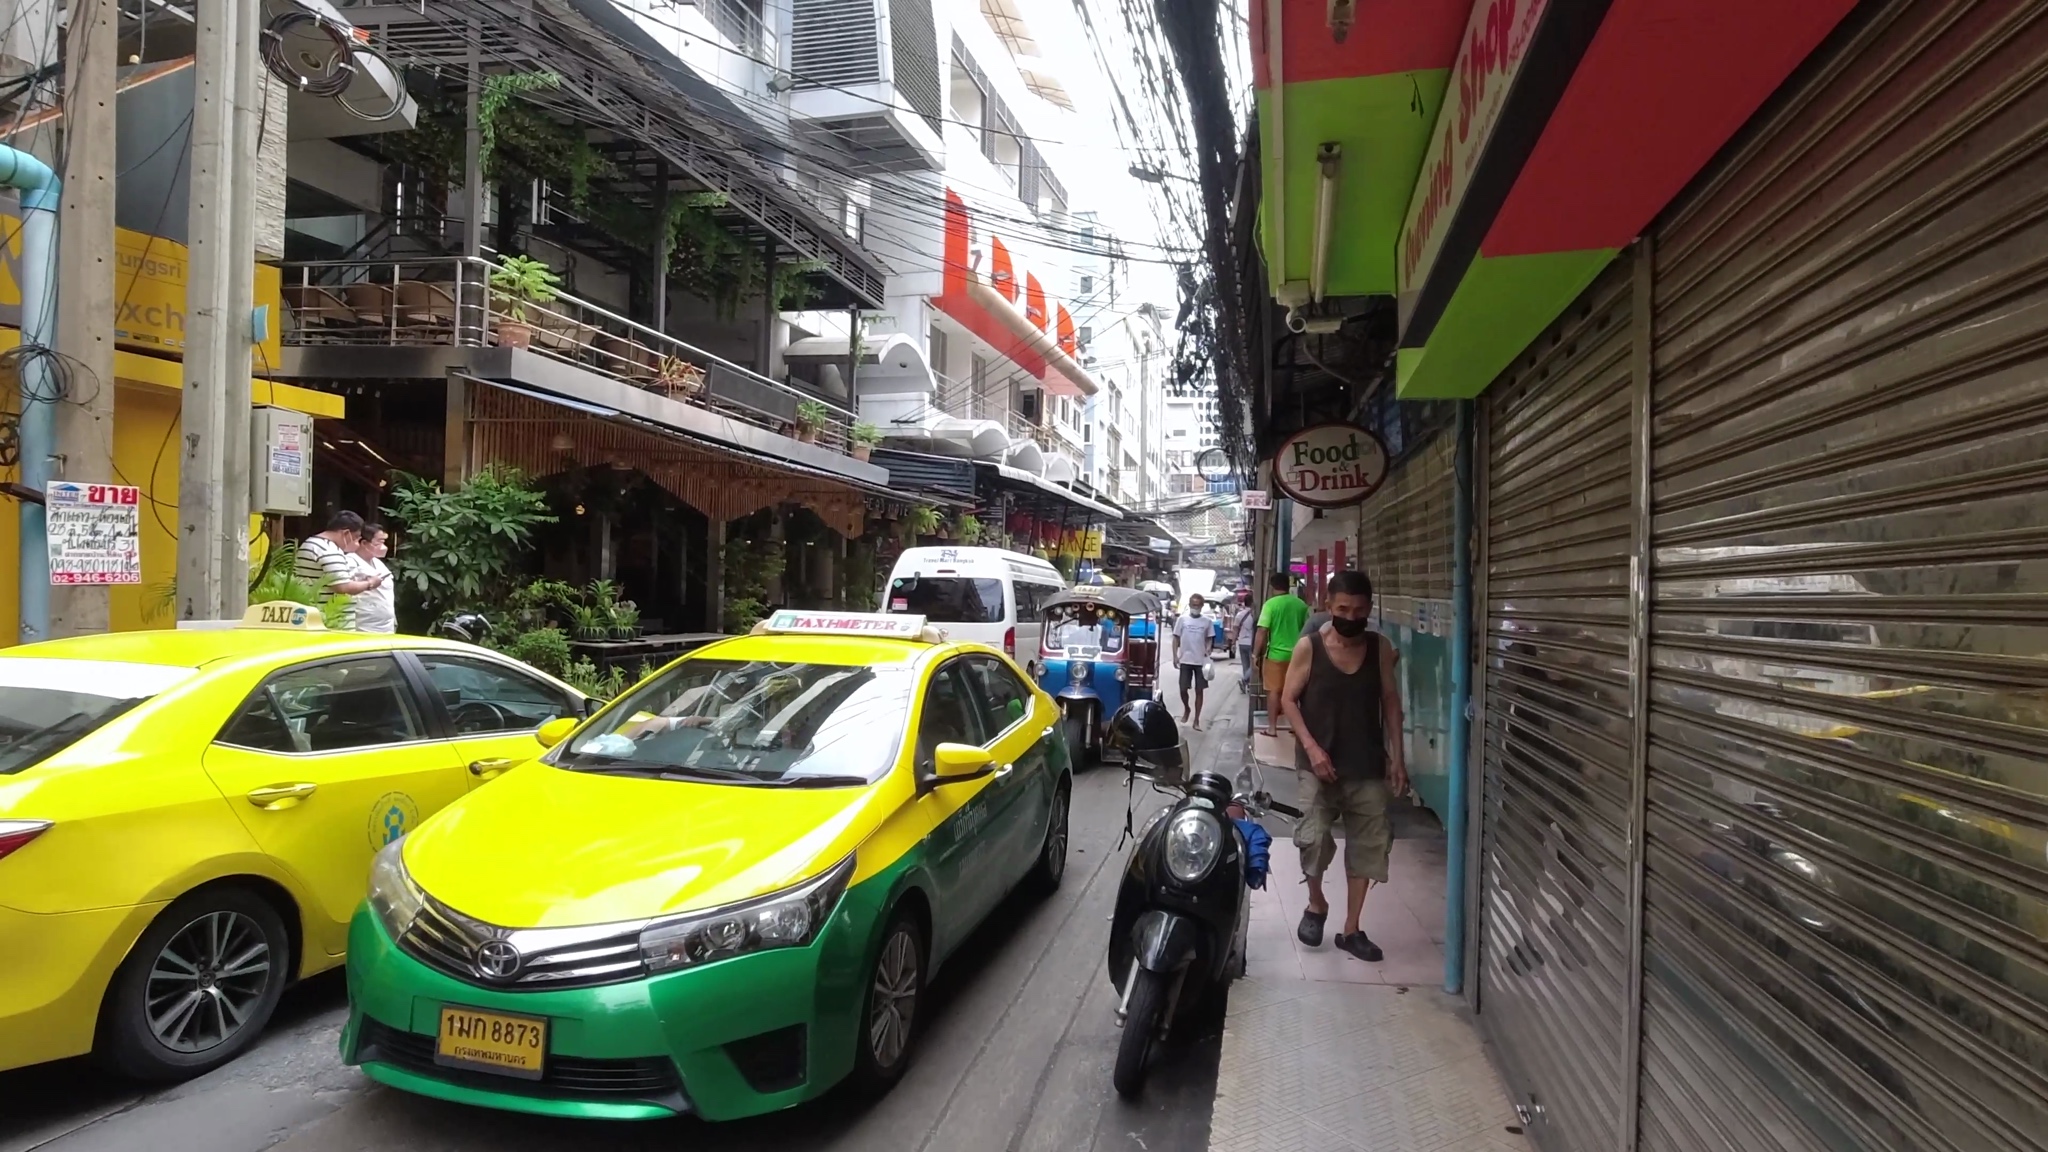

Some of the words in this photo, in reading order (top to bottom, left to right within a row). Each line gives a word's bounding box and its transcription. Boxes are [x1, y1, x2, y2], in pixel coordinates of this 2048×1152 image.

[1292, 433, 1359, 467] Food
[1338, 461, 1349, 472] &
[1298, 464, 1373, 491] Drink
[88, 485, 138, 505] ขาย
[53, 573, 138, 583] 02-946-6206
[261, 606, 293, 623] TAXI
[447, 1014, 487, 1040] 1มก
[491, 1020, 540, 1049] 8873
[454, 1046, 527, 1065] กรุงเทพมหานคร
